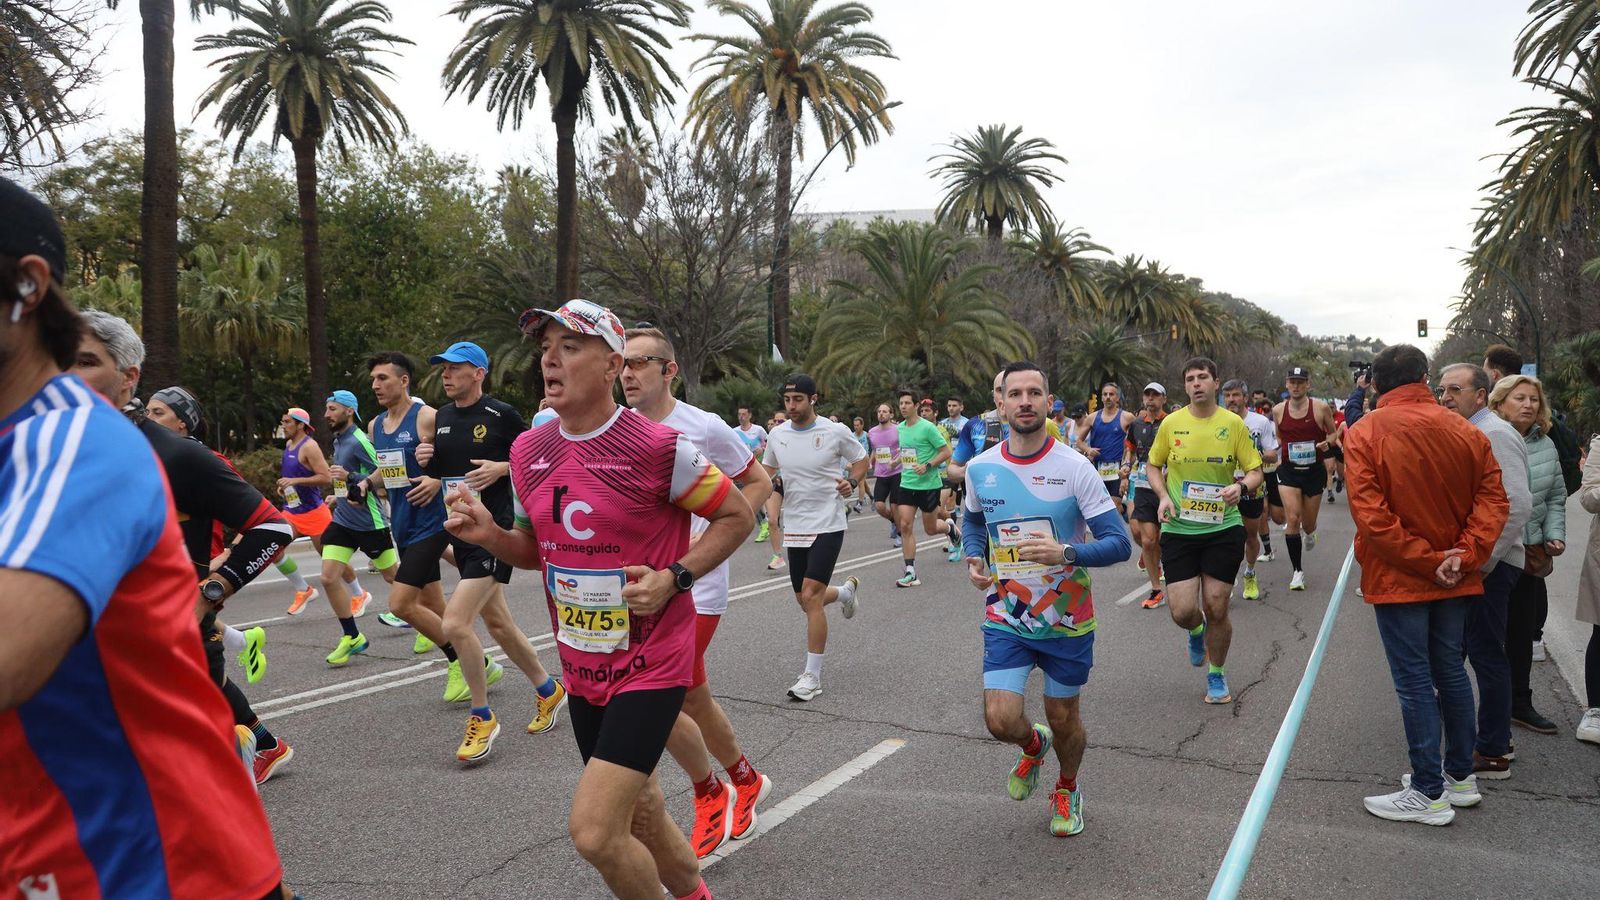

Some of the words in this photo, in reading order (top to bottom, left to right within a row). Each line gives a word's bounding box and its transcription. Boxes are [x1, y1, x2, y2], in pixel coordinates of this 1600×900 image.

[381, 467, 401, 479] 1037
[1190, 500, 1218, 513] 2579
[246, 542, 279, 575] abades
[564, 606, 614, 632] 2475
